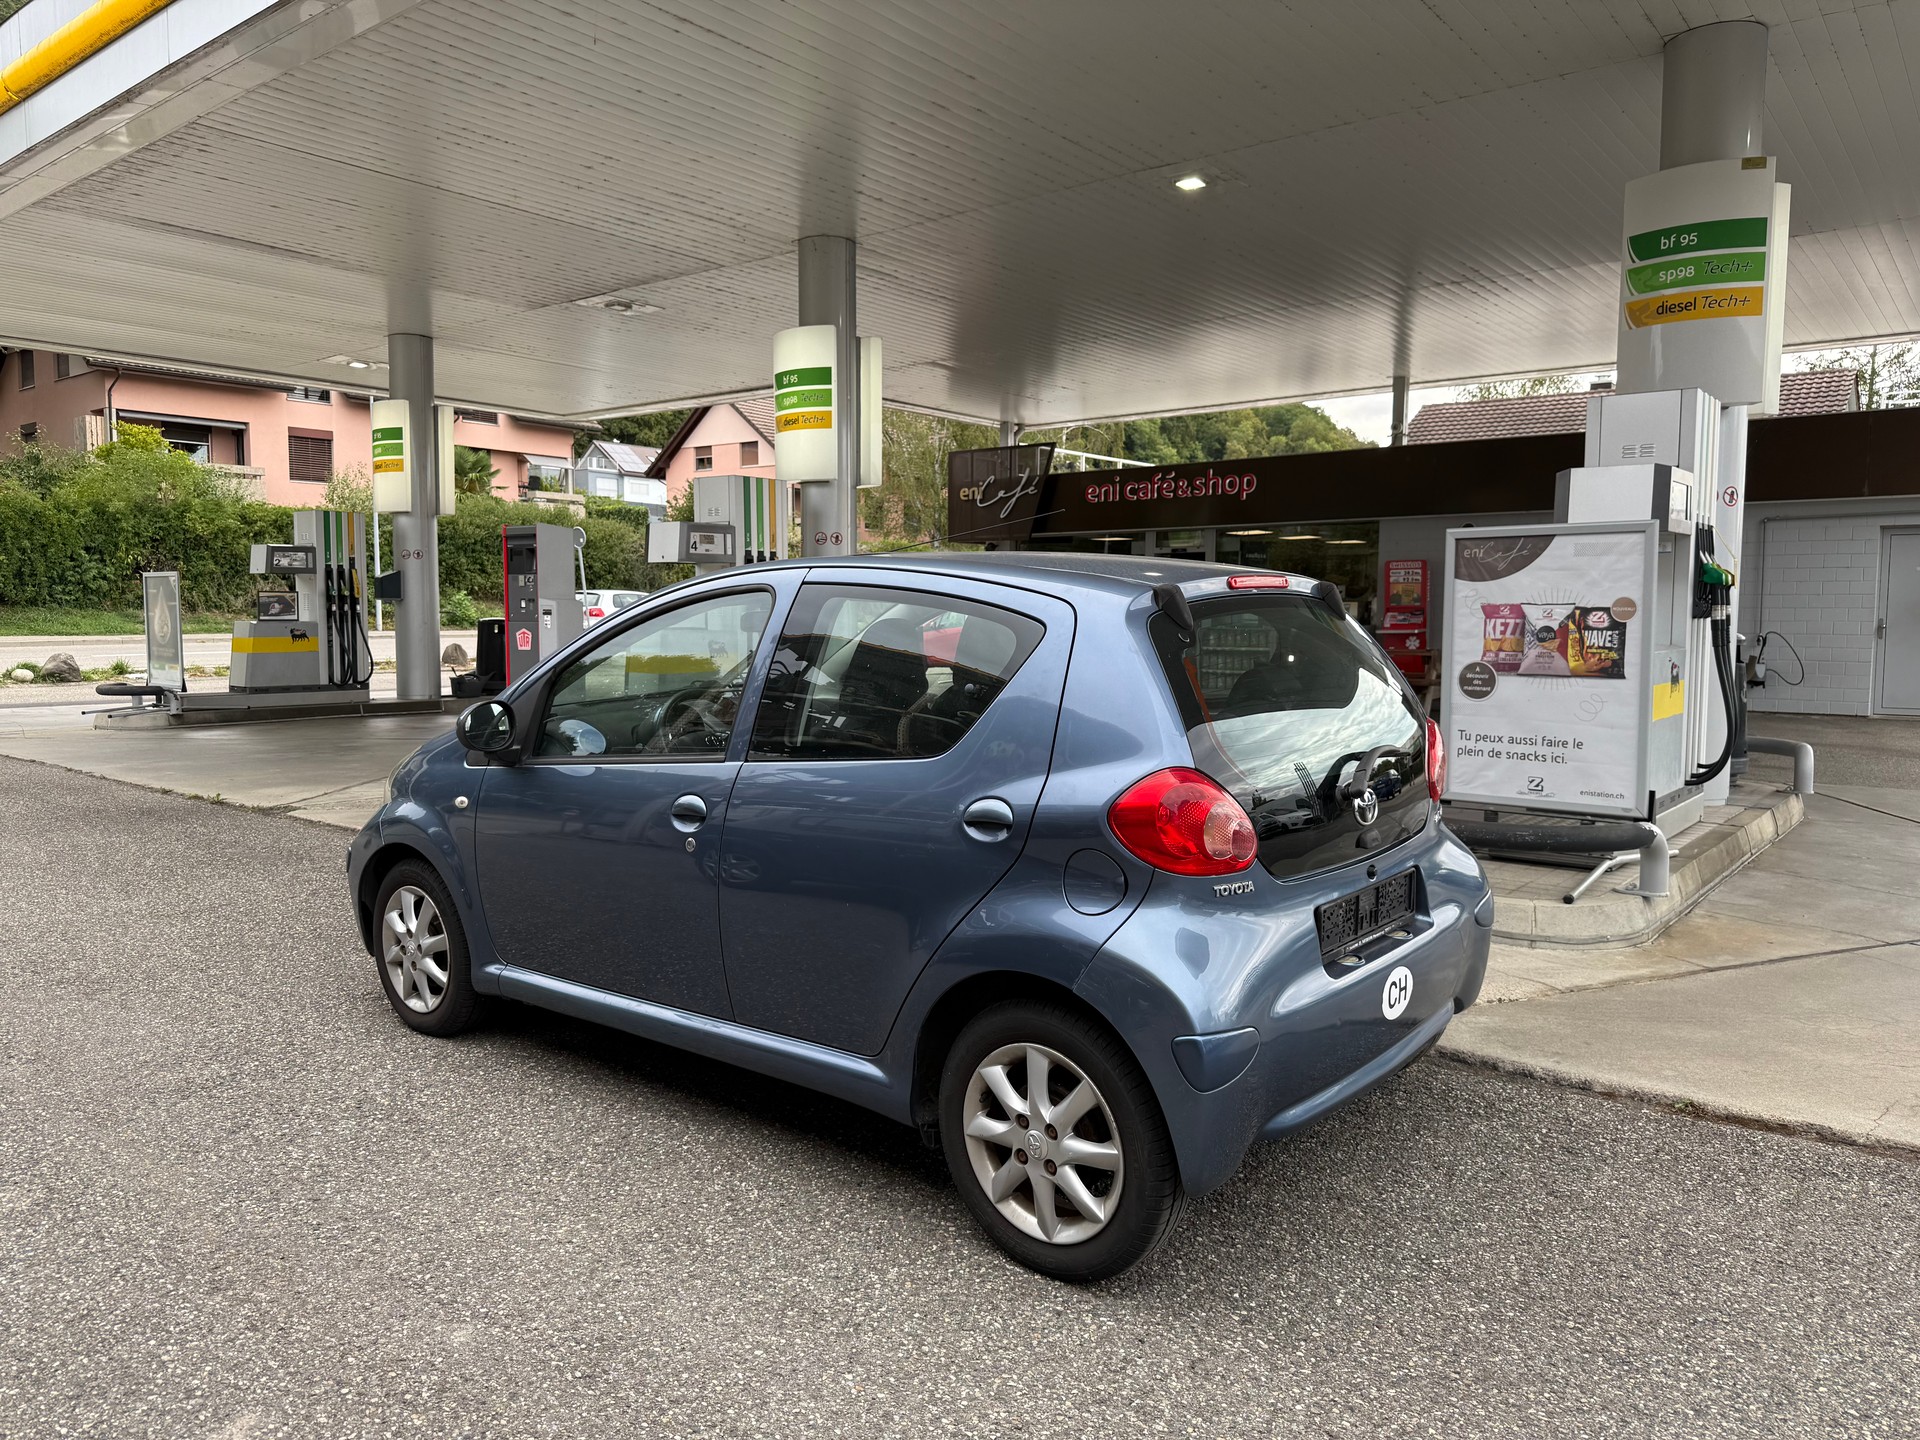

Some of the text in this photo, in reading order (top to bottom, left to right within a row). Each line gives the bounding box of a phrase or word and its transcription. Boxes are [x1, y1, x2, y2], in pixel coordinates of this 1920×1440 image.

[1660, 232, 1698, 250] bf 95
[1659, 259, 1753, 284] sp98 Tech+
[1656, 294, 1751, 315] diesel Tech+
[790, 374, 798, 383] 95
[783, 395, 798, 406] sp98
[960, 482, 984, 500] eni
[1085, 475, 1120, 503] eni
[691, 540, 698, 551] 4
[1463, 545, 1484, 558] eni
[274, 558, 281, 567] 2
[1485, 618, 1523, 640] KEZZ
[1537, 631, 1555, 640] vaya
[1457, 729, 1584, 750] Tu peux aussi faire le
[1457, 746, 1568, 764] plein de snacks ici.
[1579, 789, 1625, 800] enistation.ch
[1213, 880, 1255, 897] TOYOTA
[1388, 974, 1407, 1009] CH
